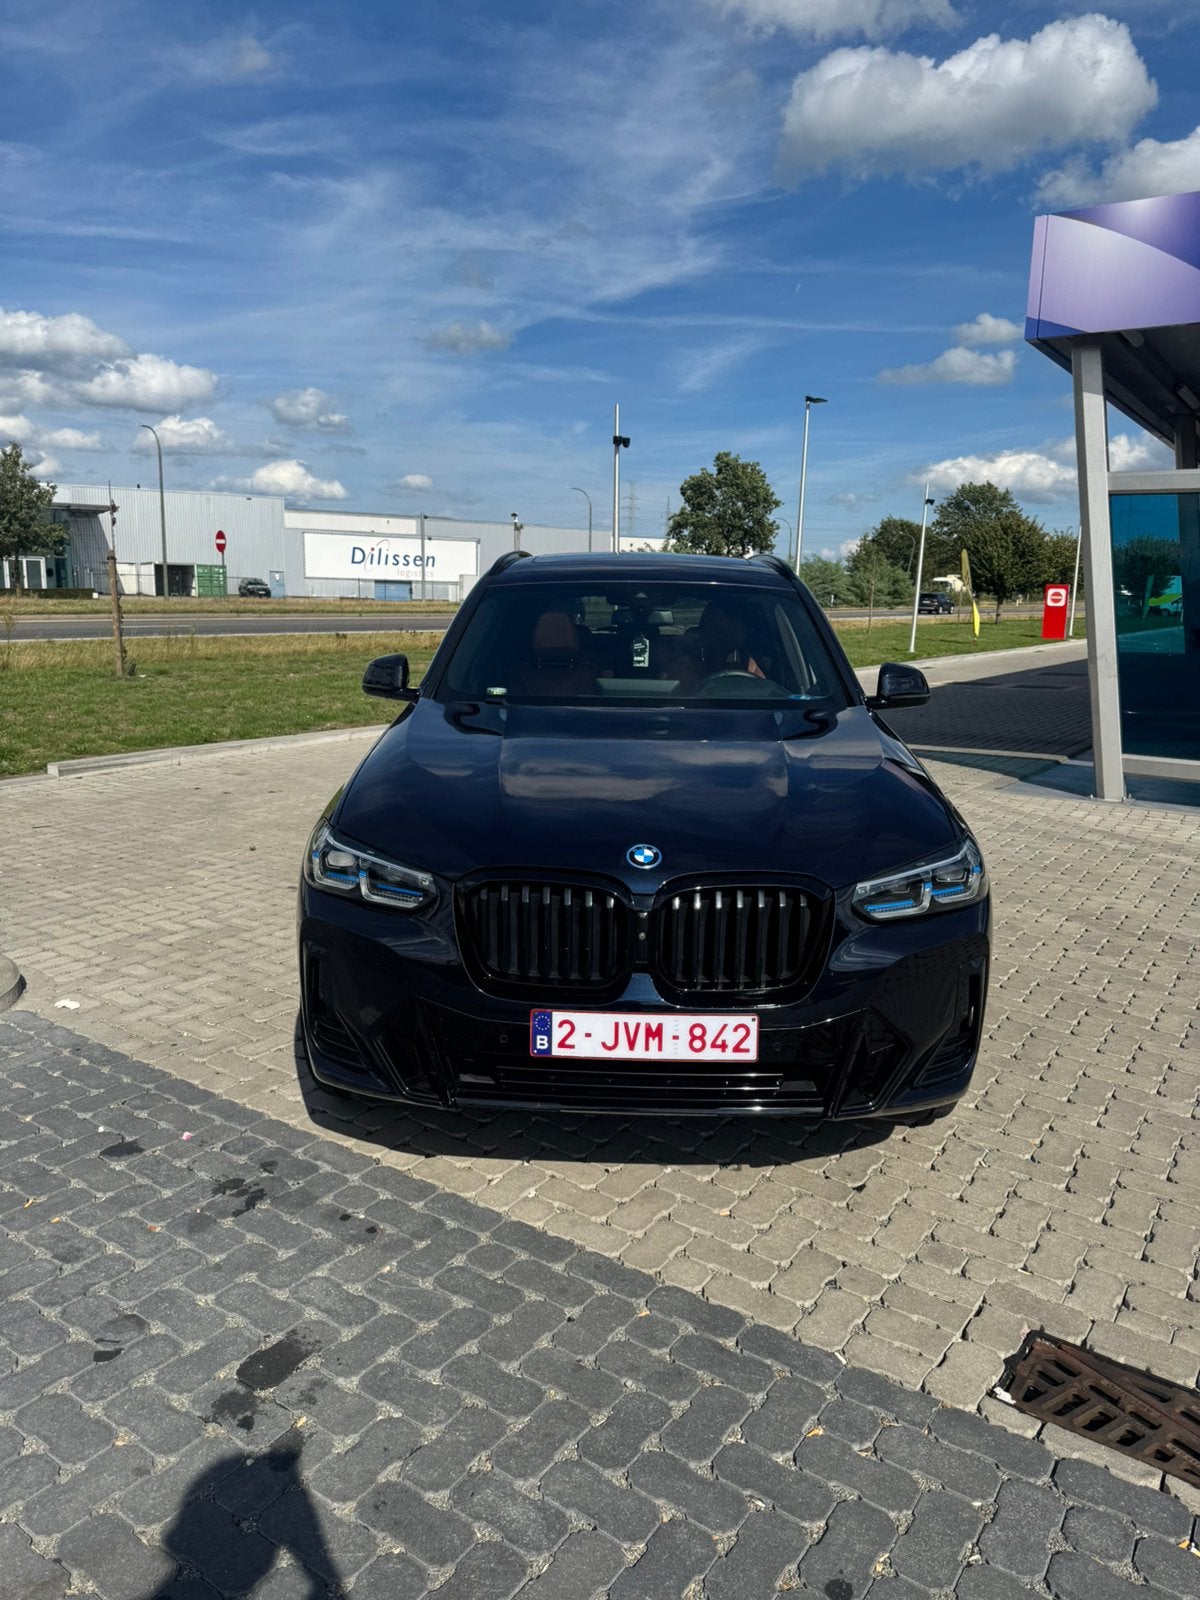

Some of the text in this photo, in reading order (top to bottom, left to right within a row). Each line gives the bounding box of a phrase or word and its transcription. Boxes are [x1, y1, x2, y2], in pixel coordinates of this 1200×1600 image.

[351, 546, 436, 568] Dilissen
[396, 568, 435, 578] logistcs
[536, 1035, 549, 1049] B
